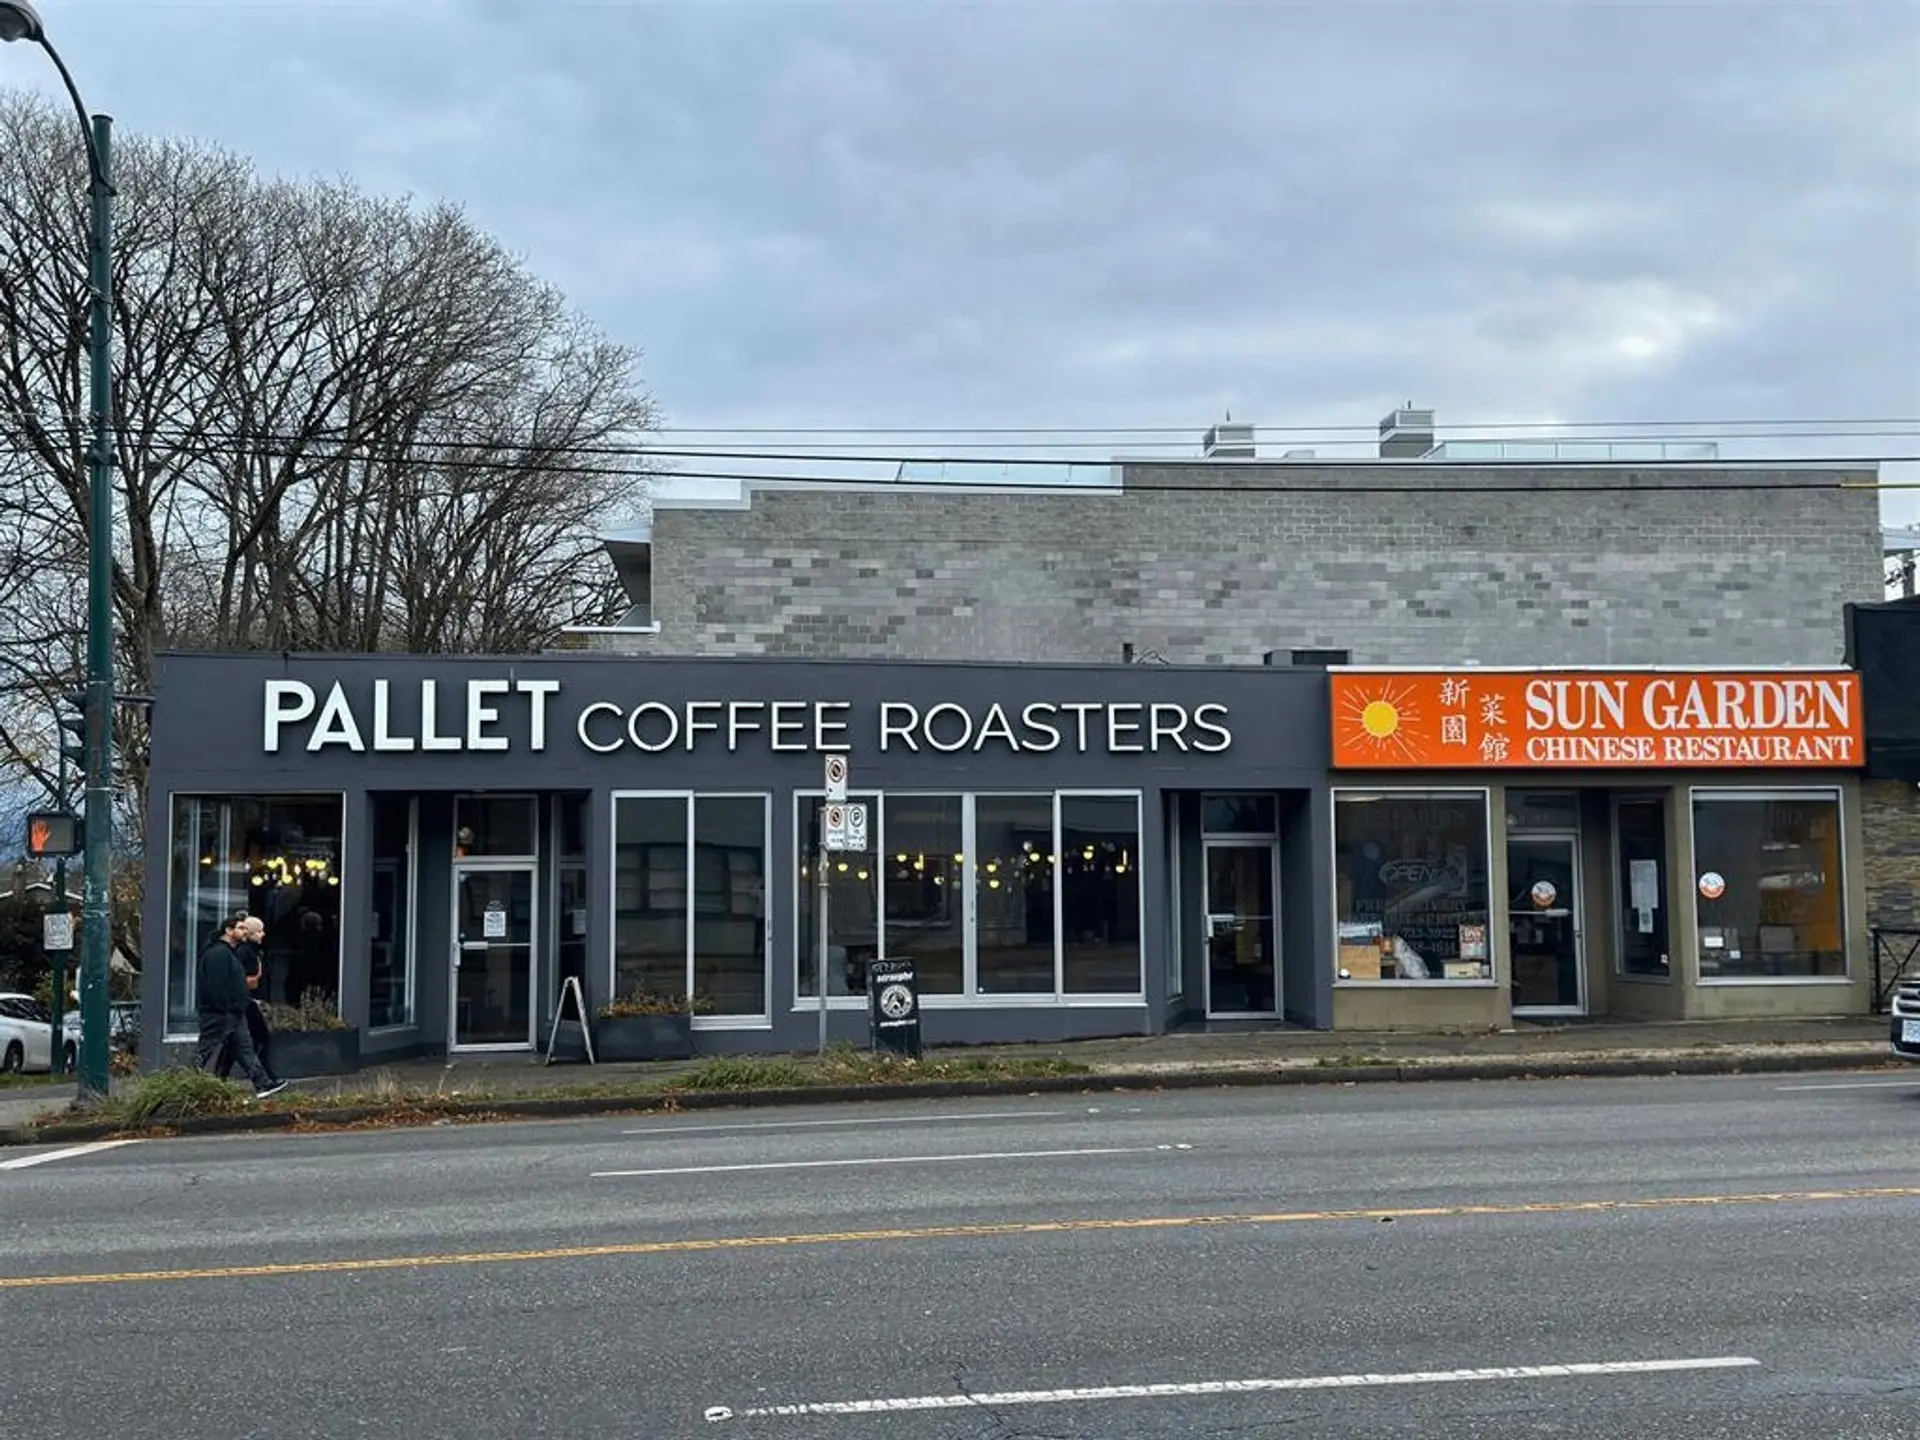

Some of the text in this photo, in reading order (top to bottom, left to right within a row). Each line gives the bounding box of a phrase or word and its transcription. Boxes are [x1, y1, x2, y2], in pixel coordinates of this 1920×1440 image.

[264, 679, 1232, 752] PALLET COFFEE ROASTERS
[1440, 678, 1470, 745] 新園
[1525, 679, 1852, 732] SUN GARDEN
[1526, 735, 1853, 763] CHINESE RESTAURANT
